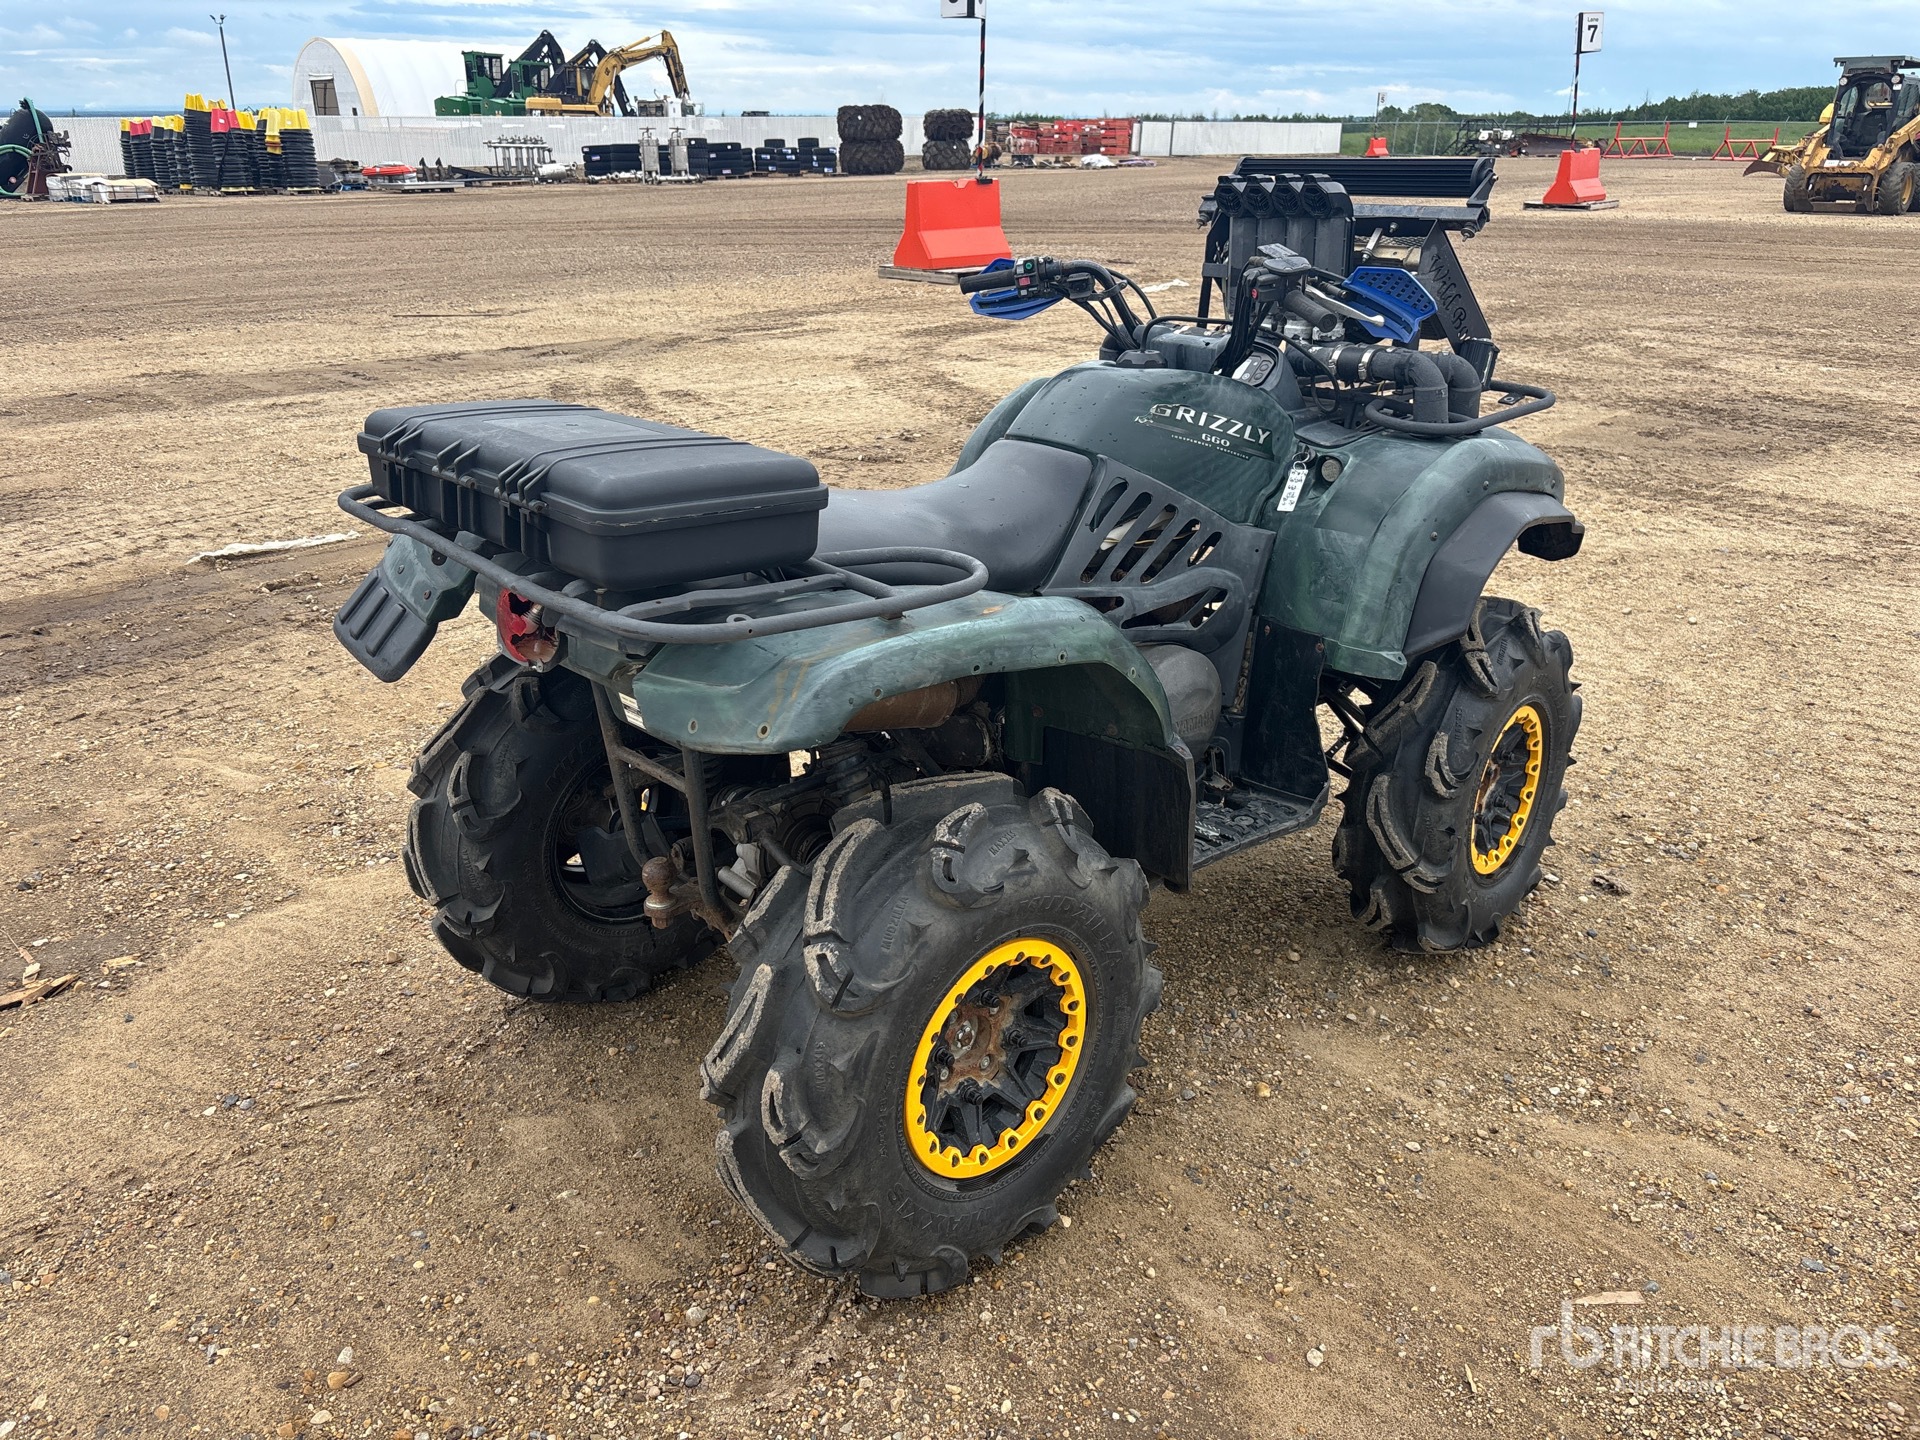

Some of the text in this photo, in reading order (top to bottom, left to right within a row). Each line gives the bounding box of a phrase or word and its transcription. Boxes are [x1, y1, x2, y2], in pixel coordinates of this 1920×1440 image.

[1587, 24, 1598, 43] 7
[1427, 254, 1462, 310] Wild
[1152, 404, 1271, 445] GRIZZLY
[1201, 433, 1231, 447] 660
[881, 895, 909, 953] MUDZILLA
